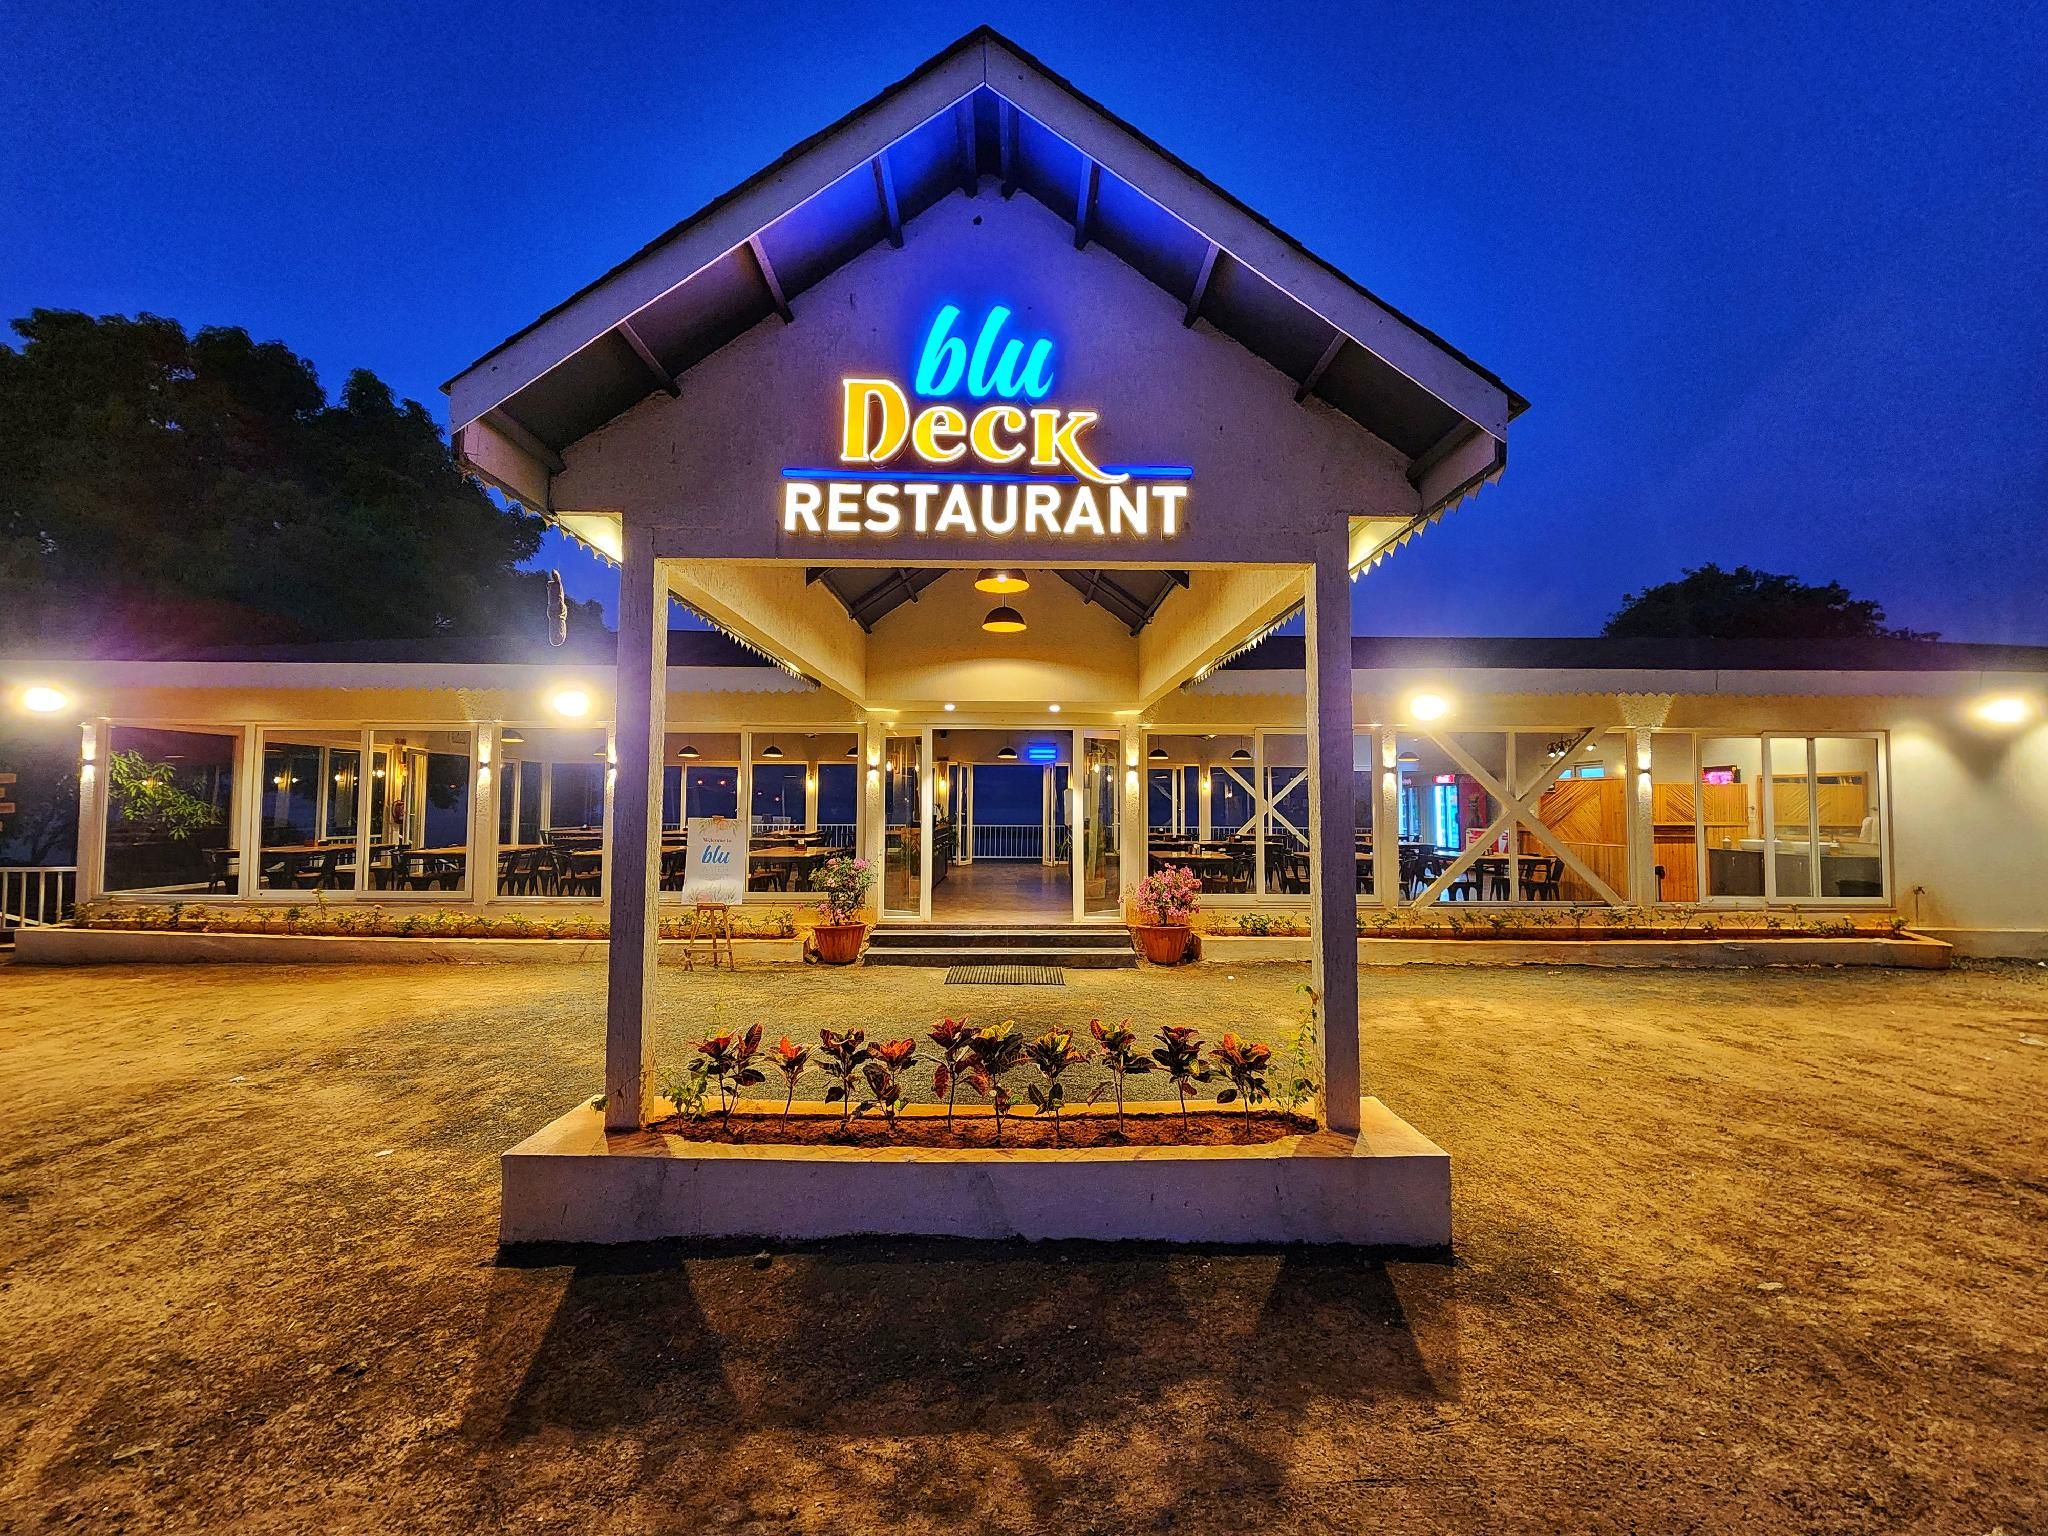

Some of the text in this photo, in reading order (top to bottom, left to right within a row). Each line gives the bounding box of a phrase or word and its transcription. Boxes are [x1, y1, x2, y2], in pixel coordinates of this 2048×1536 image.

[915, 304, 1054, 397] blu
[784, 483, 1187, 535] RESTAURANT
[701, 845, 730, 863] blu
